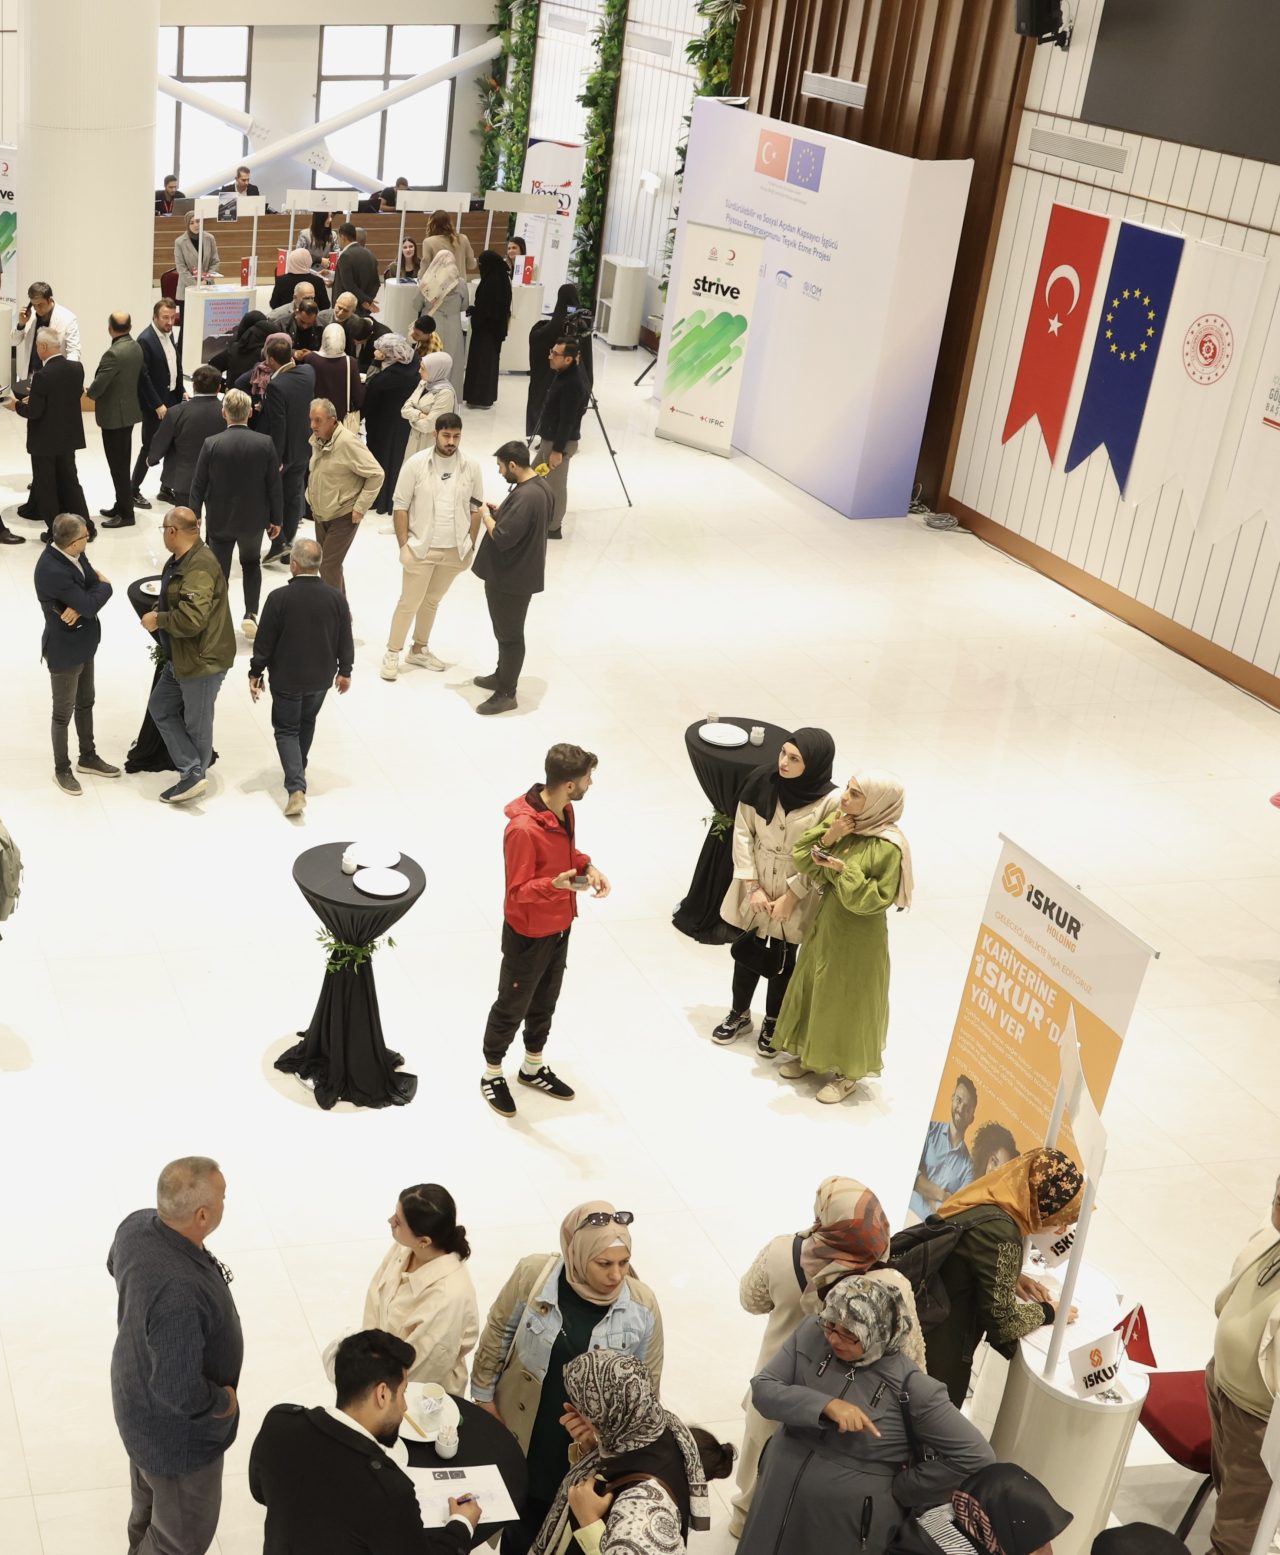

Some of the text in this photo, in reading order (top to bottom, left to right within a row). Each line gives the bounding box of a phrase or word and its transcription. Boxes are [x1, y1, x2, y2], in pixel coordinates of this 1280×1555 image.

[693, 275, 741, 300] strive
[1046, 923, 1077, 953] HOLDİNG
[981, 933, 1058, 1009] KARİYERİNE
[971, 983, 1025, 1045] YÖN VER
